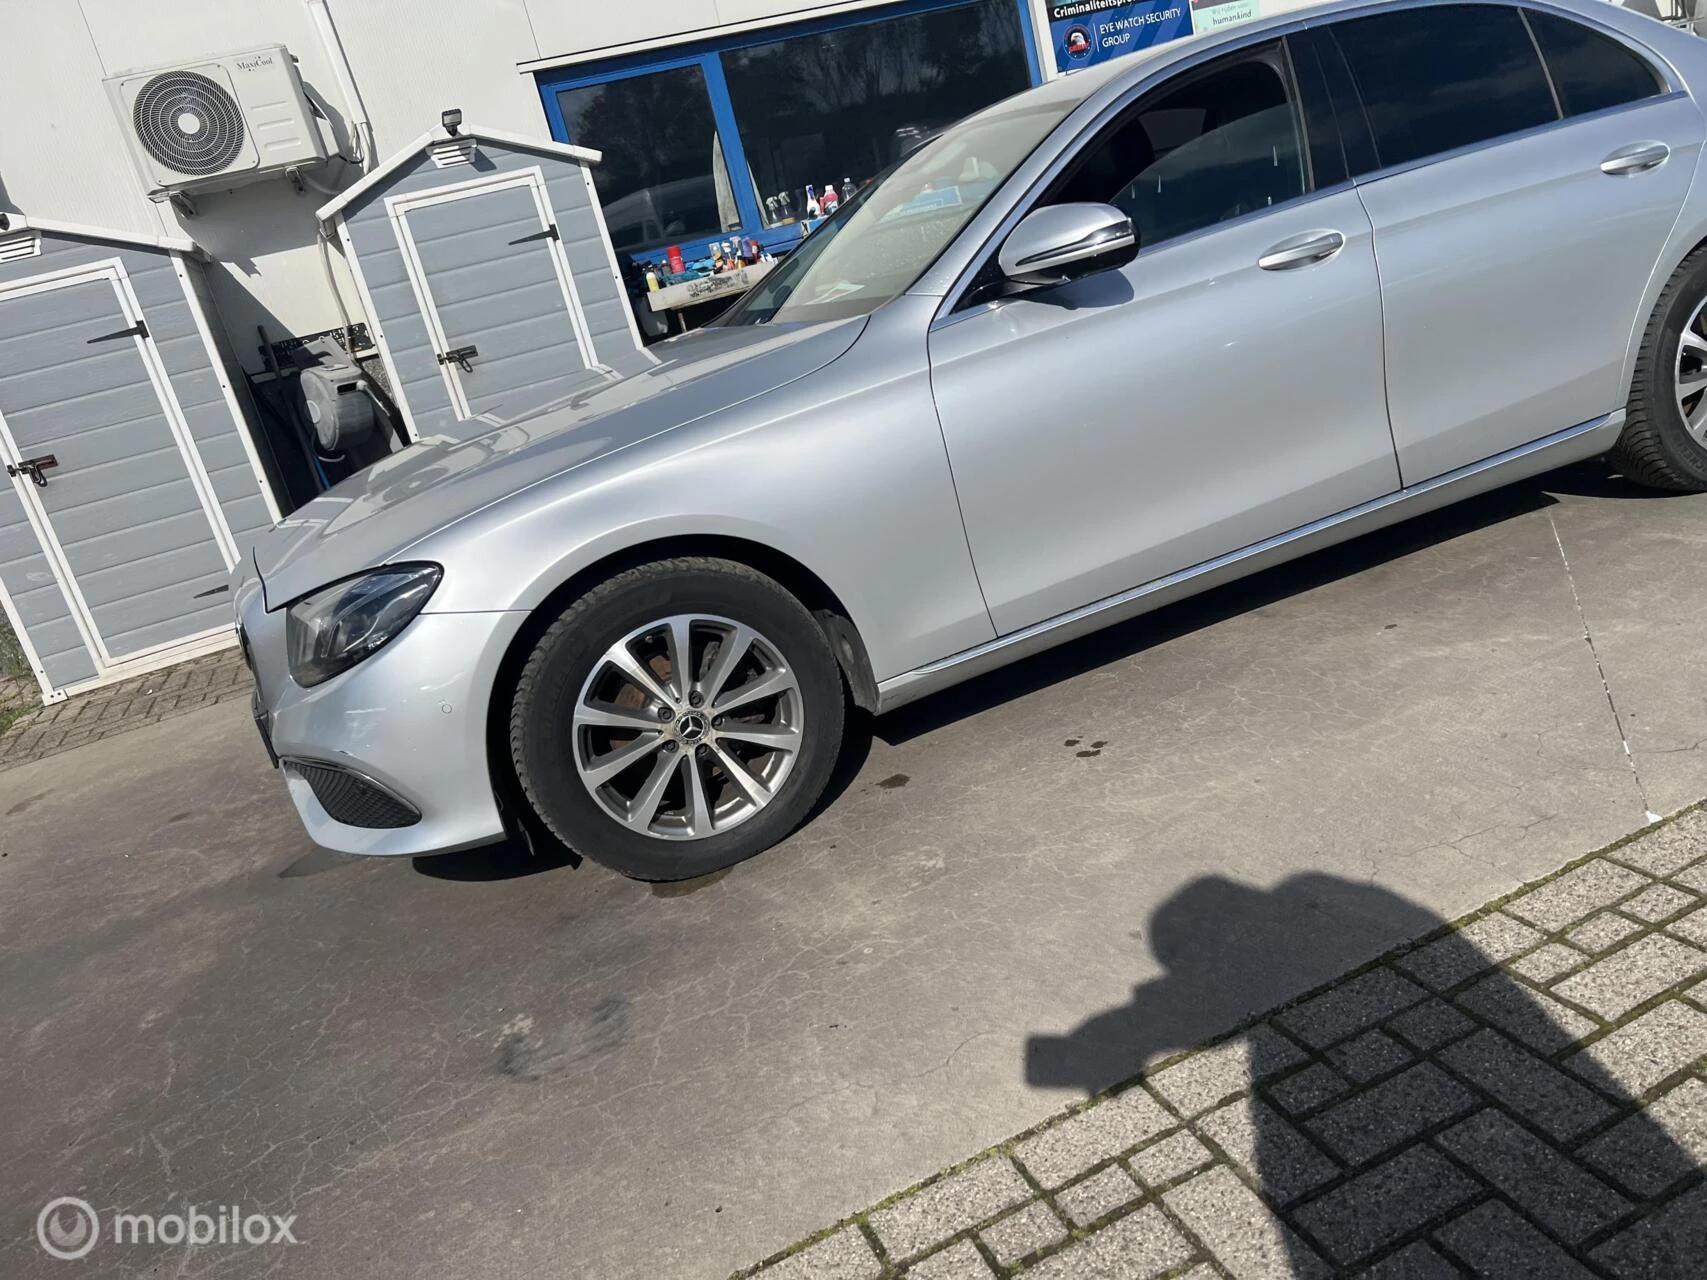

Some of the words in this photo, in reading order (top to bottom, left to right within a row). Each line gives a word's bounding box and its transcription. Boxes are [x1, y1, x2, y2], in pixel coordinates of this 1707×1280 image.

[1100, 22, 1115, 35] EYE
[1114, 16, 1145, 31] WATCH
[1146, 7, 1181, 24] SECURITY
[1212, 9, 1252, 25] humankind
[1102, 33, 1130, 48] GROUP
[236, 56, 273, 70] MaxiCool
